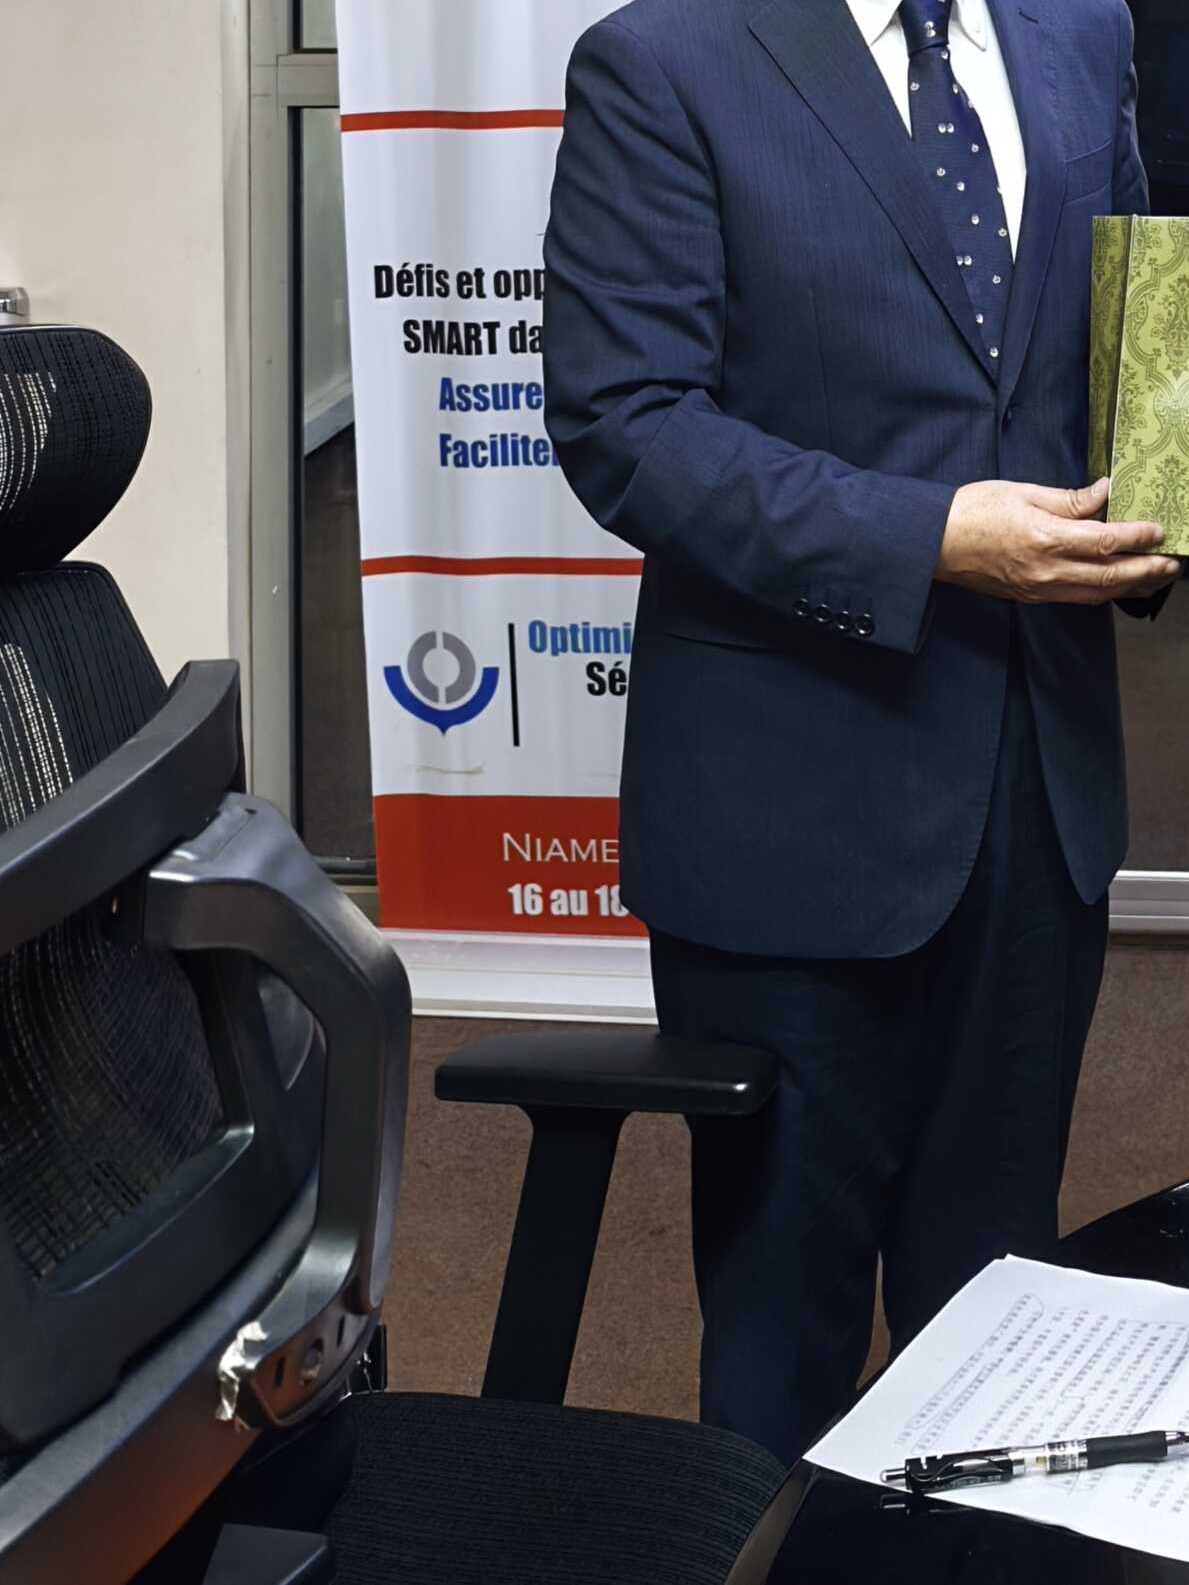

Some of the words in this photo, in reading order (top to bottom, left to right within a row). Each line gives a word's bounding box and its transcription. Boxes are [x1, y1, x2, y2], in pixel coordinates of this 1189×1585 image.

[374, 263, 450, 299] Défis
[456, 268, 486, 299] et
[403, 319, 501, 355] SMART
[439, 377, 543, 412] Assure
[528, 619, 632, 656] Optimi
[586, 661, 627, 696] Sé
[507, 883, 543, 915] 16
[550, 889, 589, 915] au
